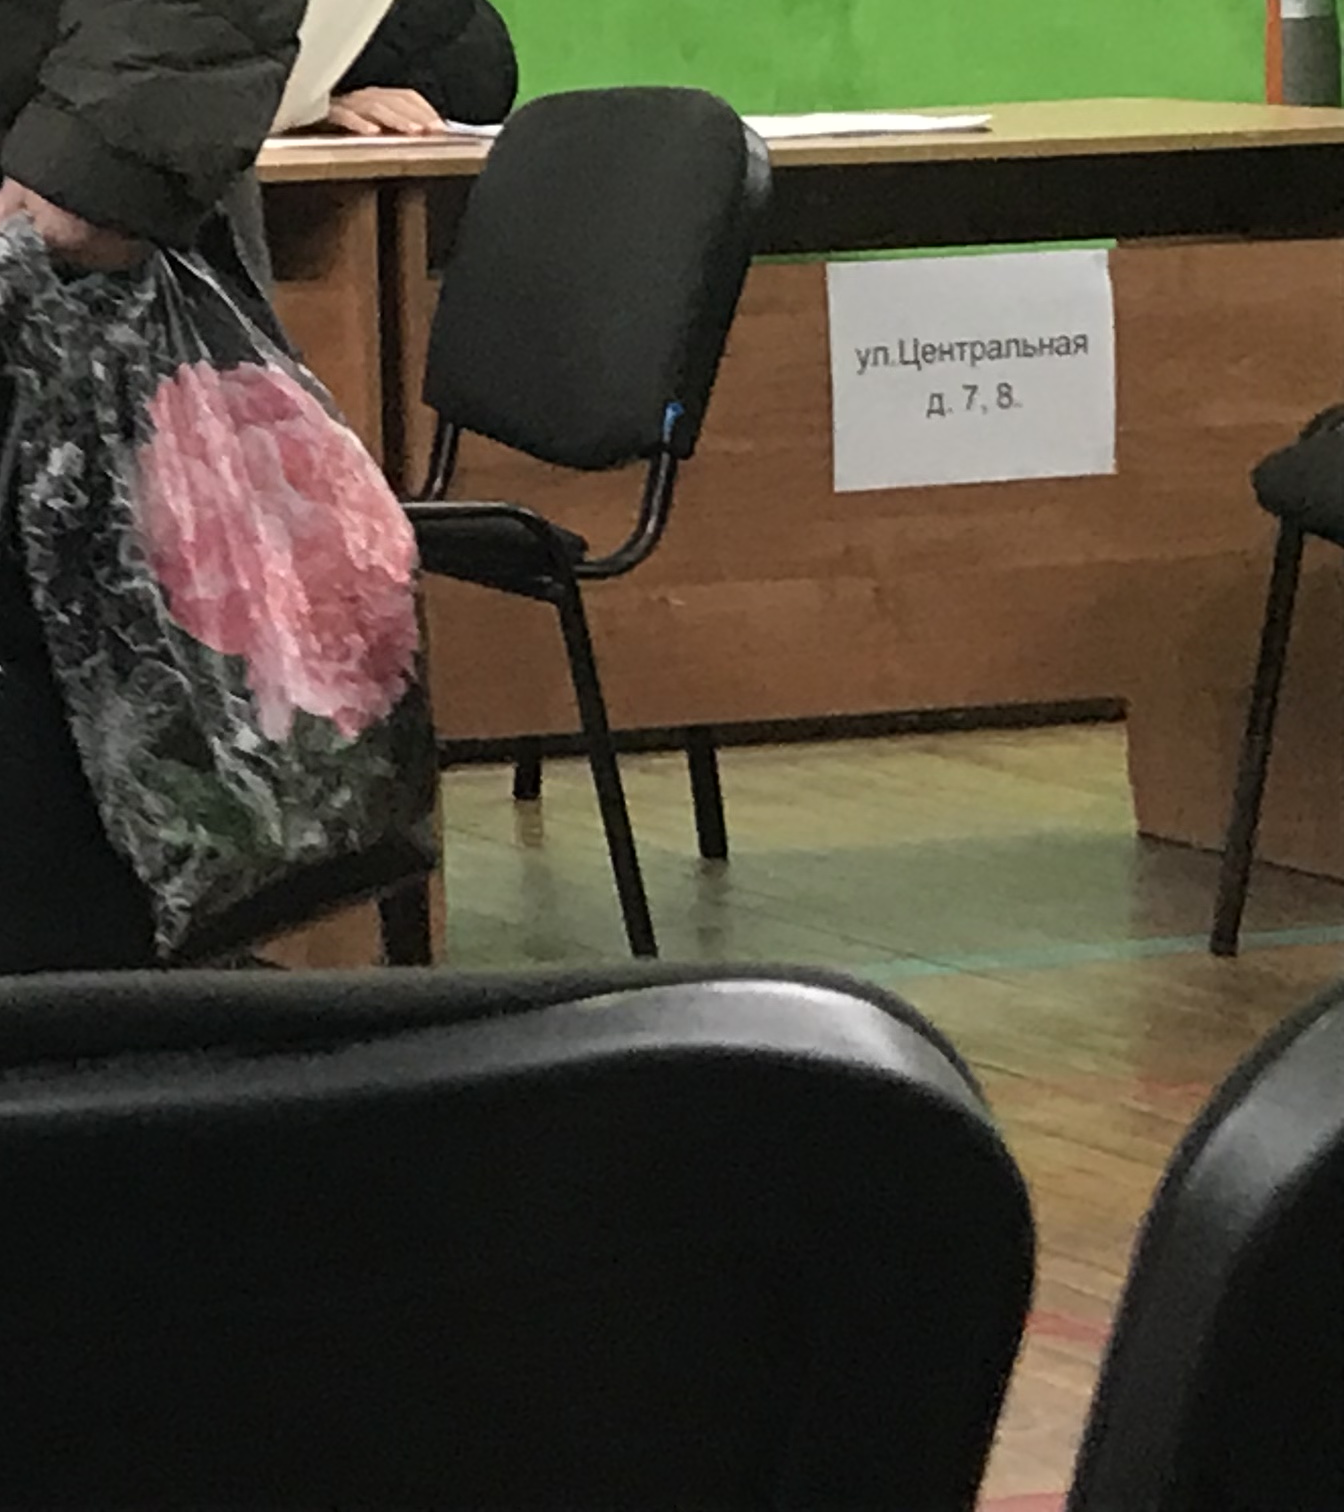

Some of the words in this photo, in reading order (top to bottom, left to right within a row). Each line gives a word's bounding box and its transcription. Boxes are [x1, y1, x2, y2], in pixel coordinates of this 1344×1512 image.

[854, 333, 1089, 375] ул.Центральная
[925, 392, 954, 418] д.
[962, 384, 988, 414] 7,
